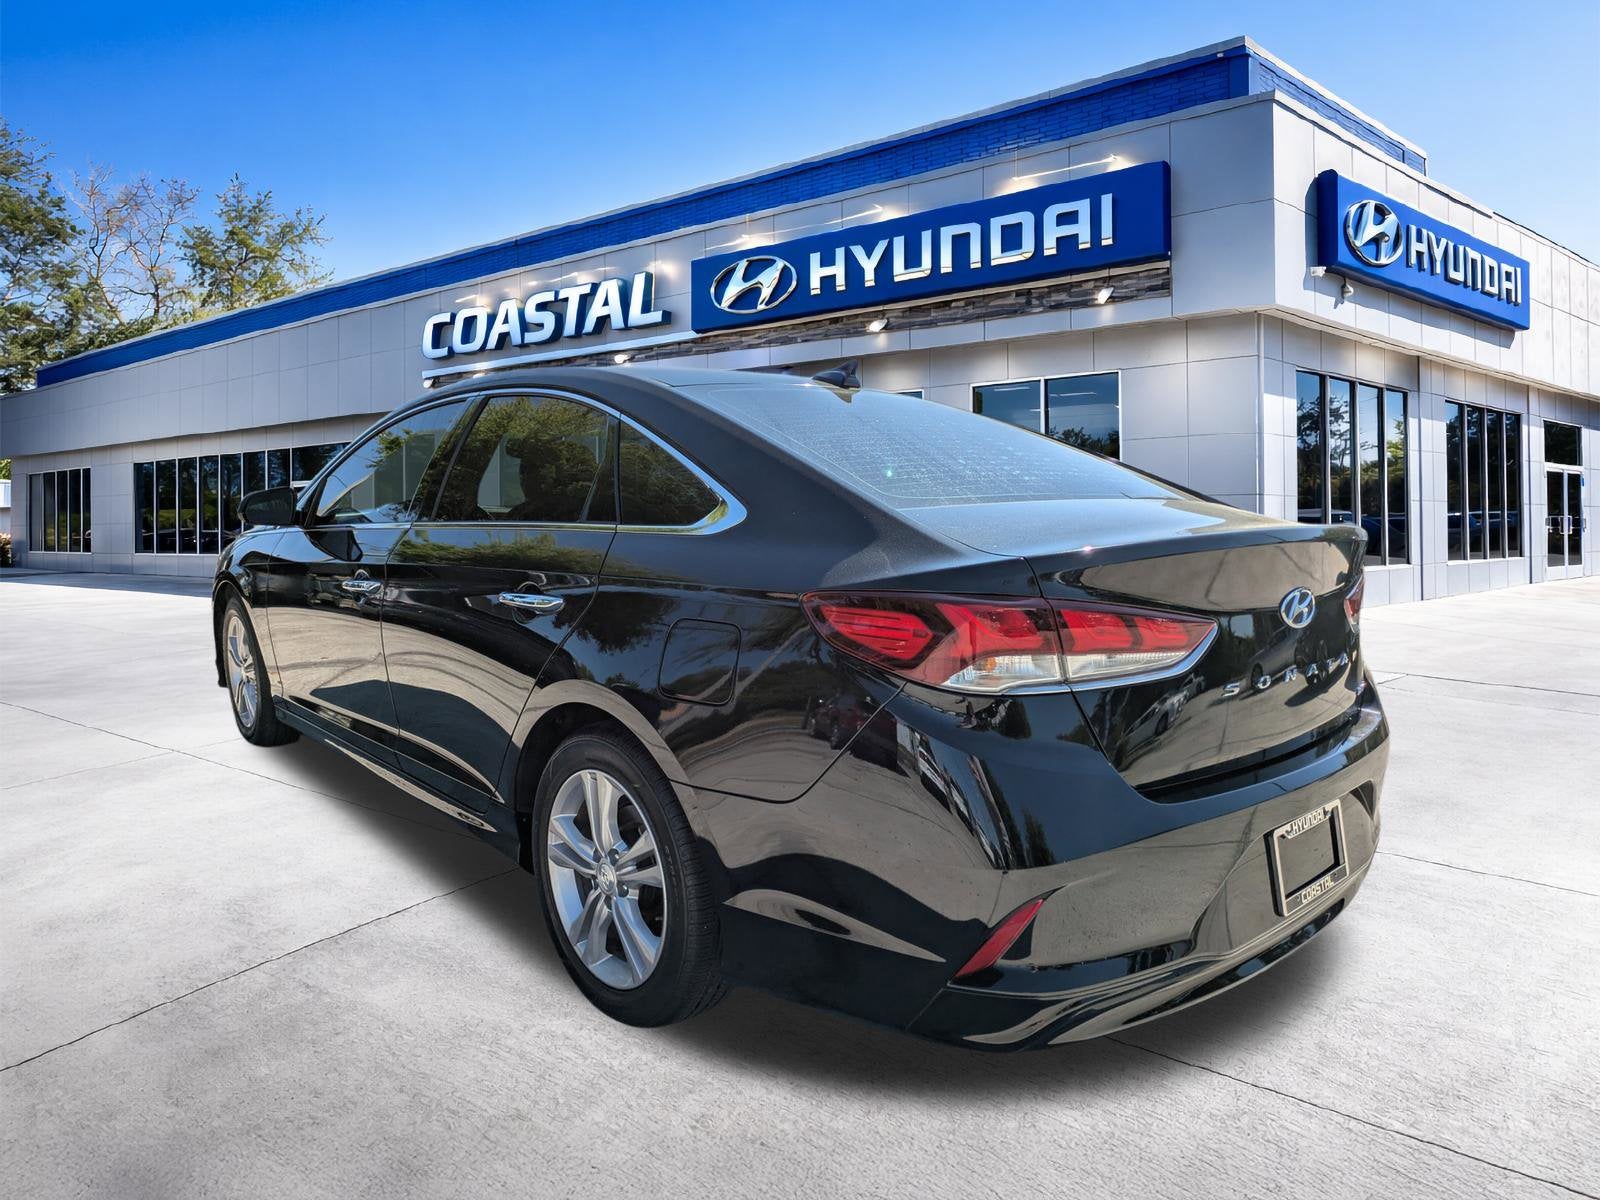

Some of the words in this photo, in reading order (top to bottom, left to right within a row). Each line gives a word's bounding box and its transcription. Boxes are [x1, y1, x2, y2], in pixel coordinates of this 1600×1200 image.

[809, 193, 1114, 295] HYUNDAI
[1406, 224, 1522, 305] HYUNDAI
[422, 271, 668, 359] COASTAL
[1221, 652, 1349, 698] SONATA
[1301, 875, 1335, 904] COASTAL
